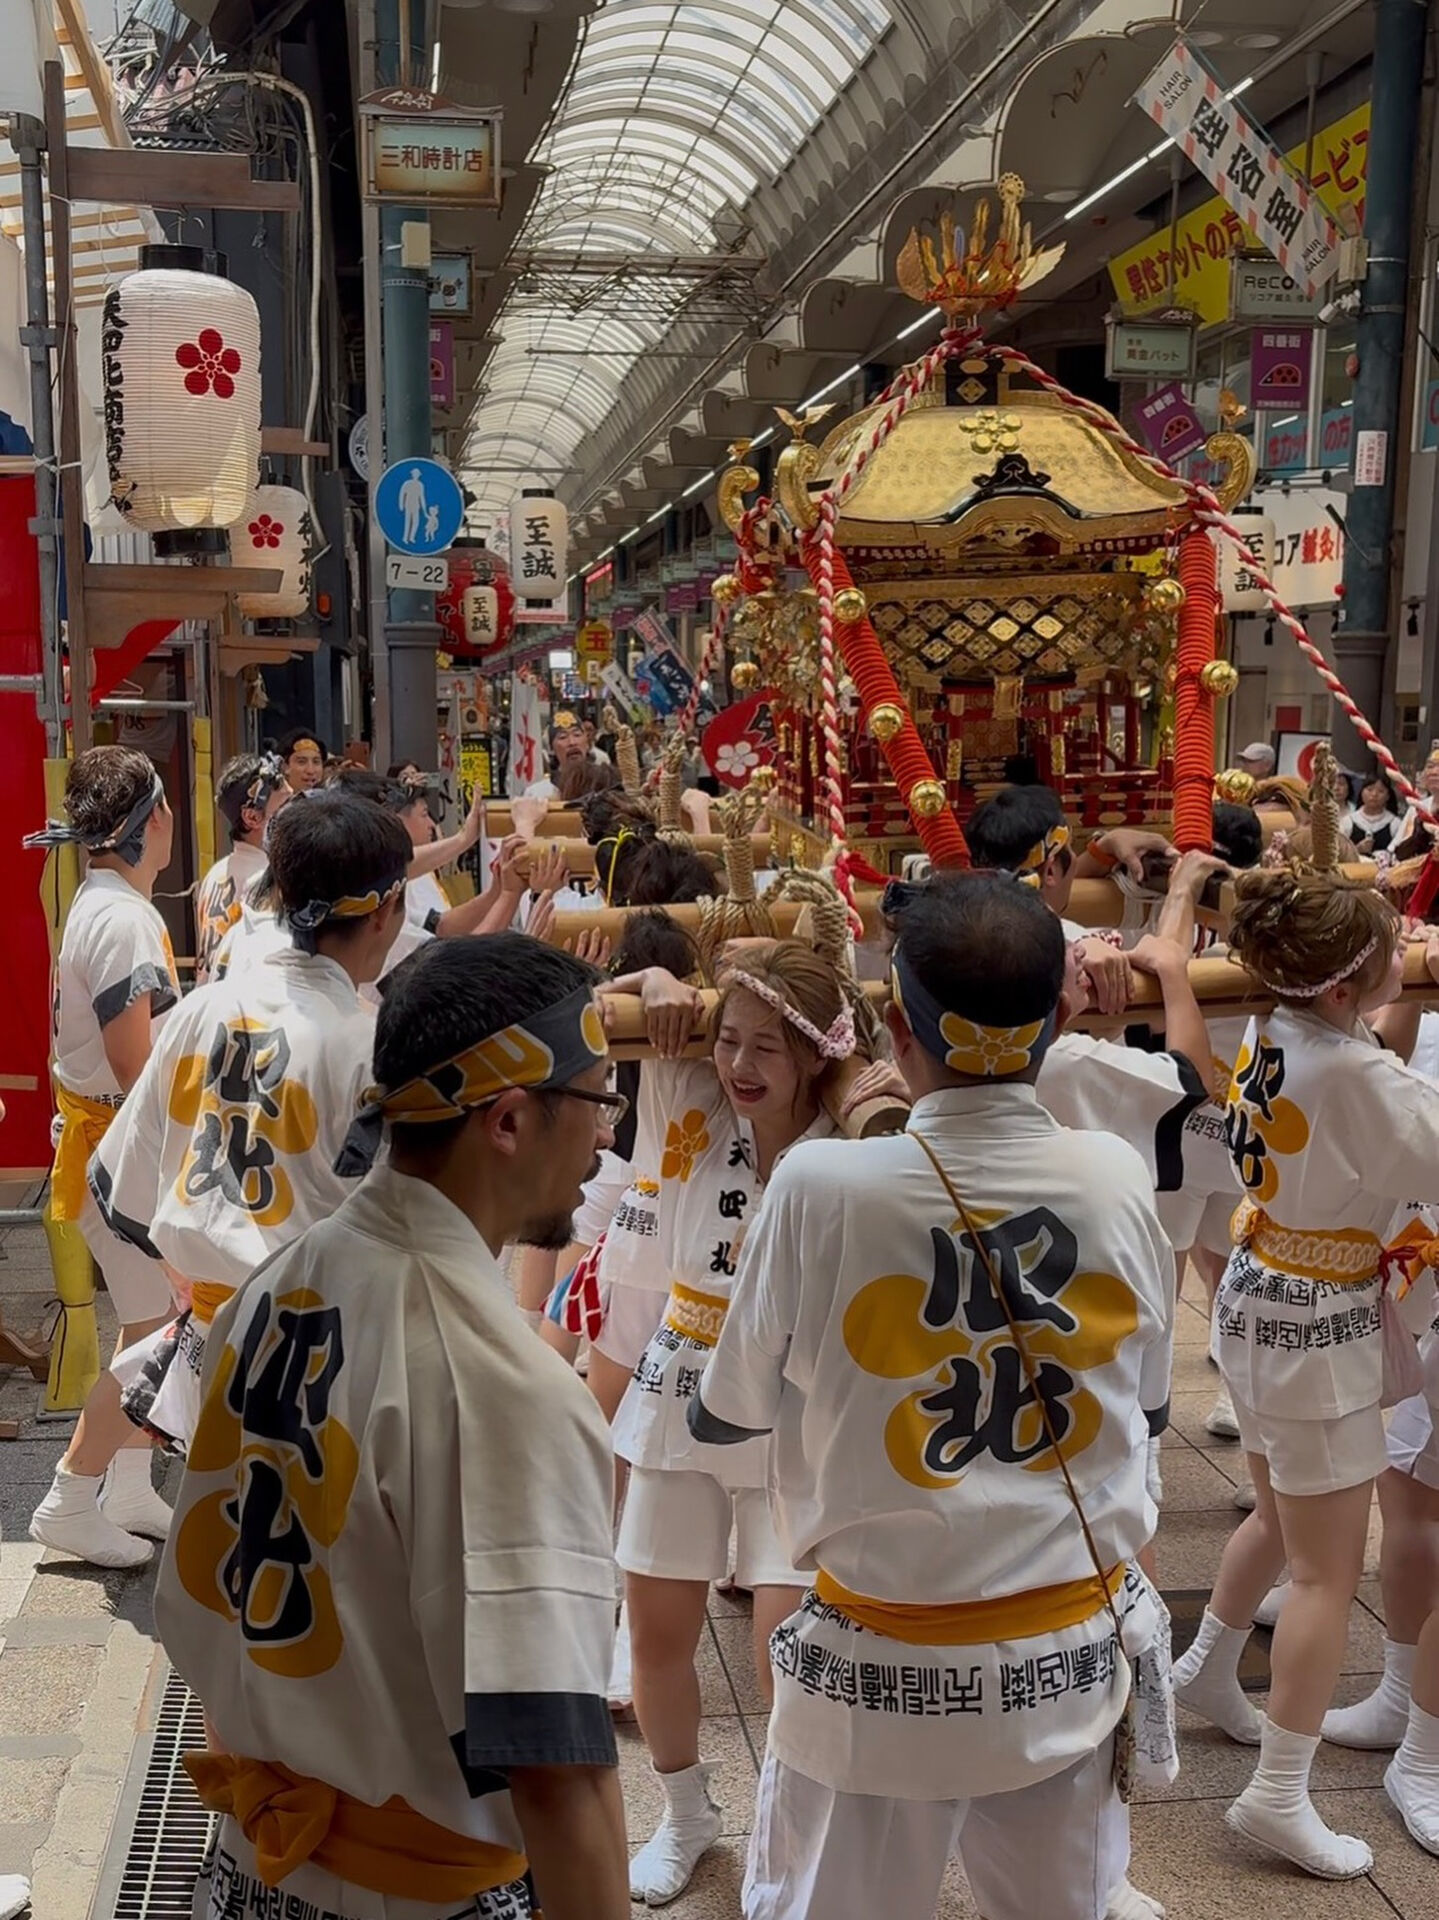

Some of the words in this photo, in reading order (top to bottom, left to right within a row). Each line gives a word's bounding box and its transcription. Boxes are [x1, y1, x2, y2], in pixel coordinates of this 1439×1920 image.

[1159, 69, 1183, 97] HAIR
[1164, 75, 1193, 112] SALON
[381, 144, 483, 173] 三和時計店
[1188, 96, 1304, 246] 理容室
[1305, 247, 1332, 275] SALON
[1244, 275, 1301, 291] ReCO
[1262, 334, 1302, 349] 四番街
[520, 515, 557, 580] 至誠
[1234, 532, 1265, 592] 至誠
[1274, 526, 1344, 566] コア鍼灸
[391, 562, 445, 584] 7-22
[471, 596, 492, 634] 至誠
